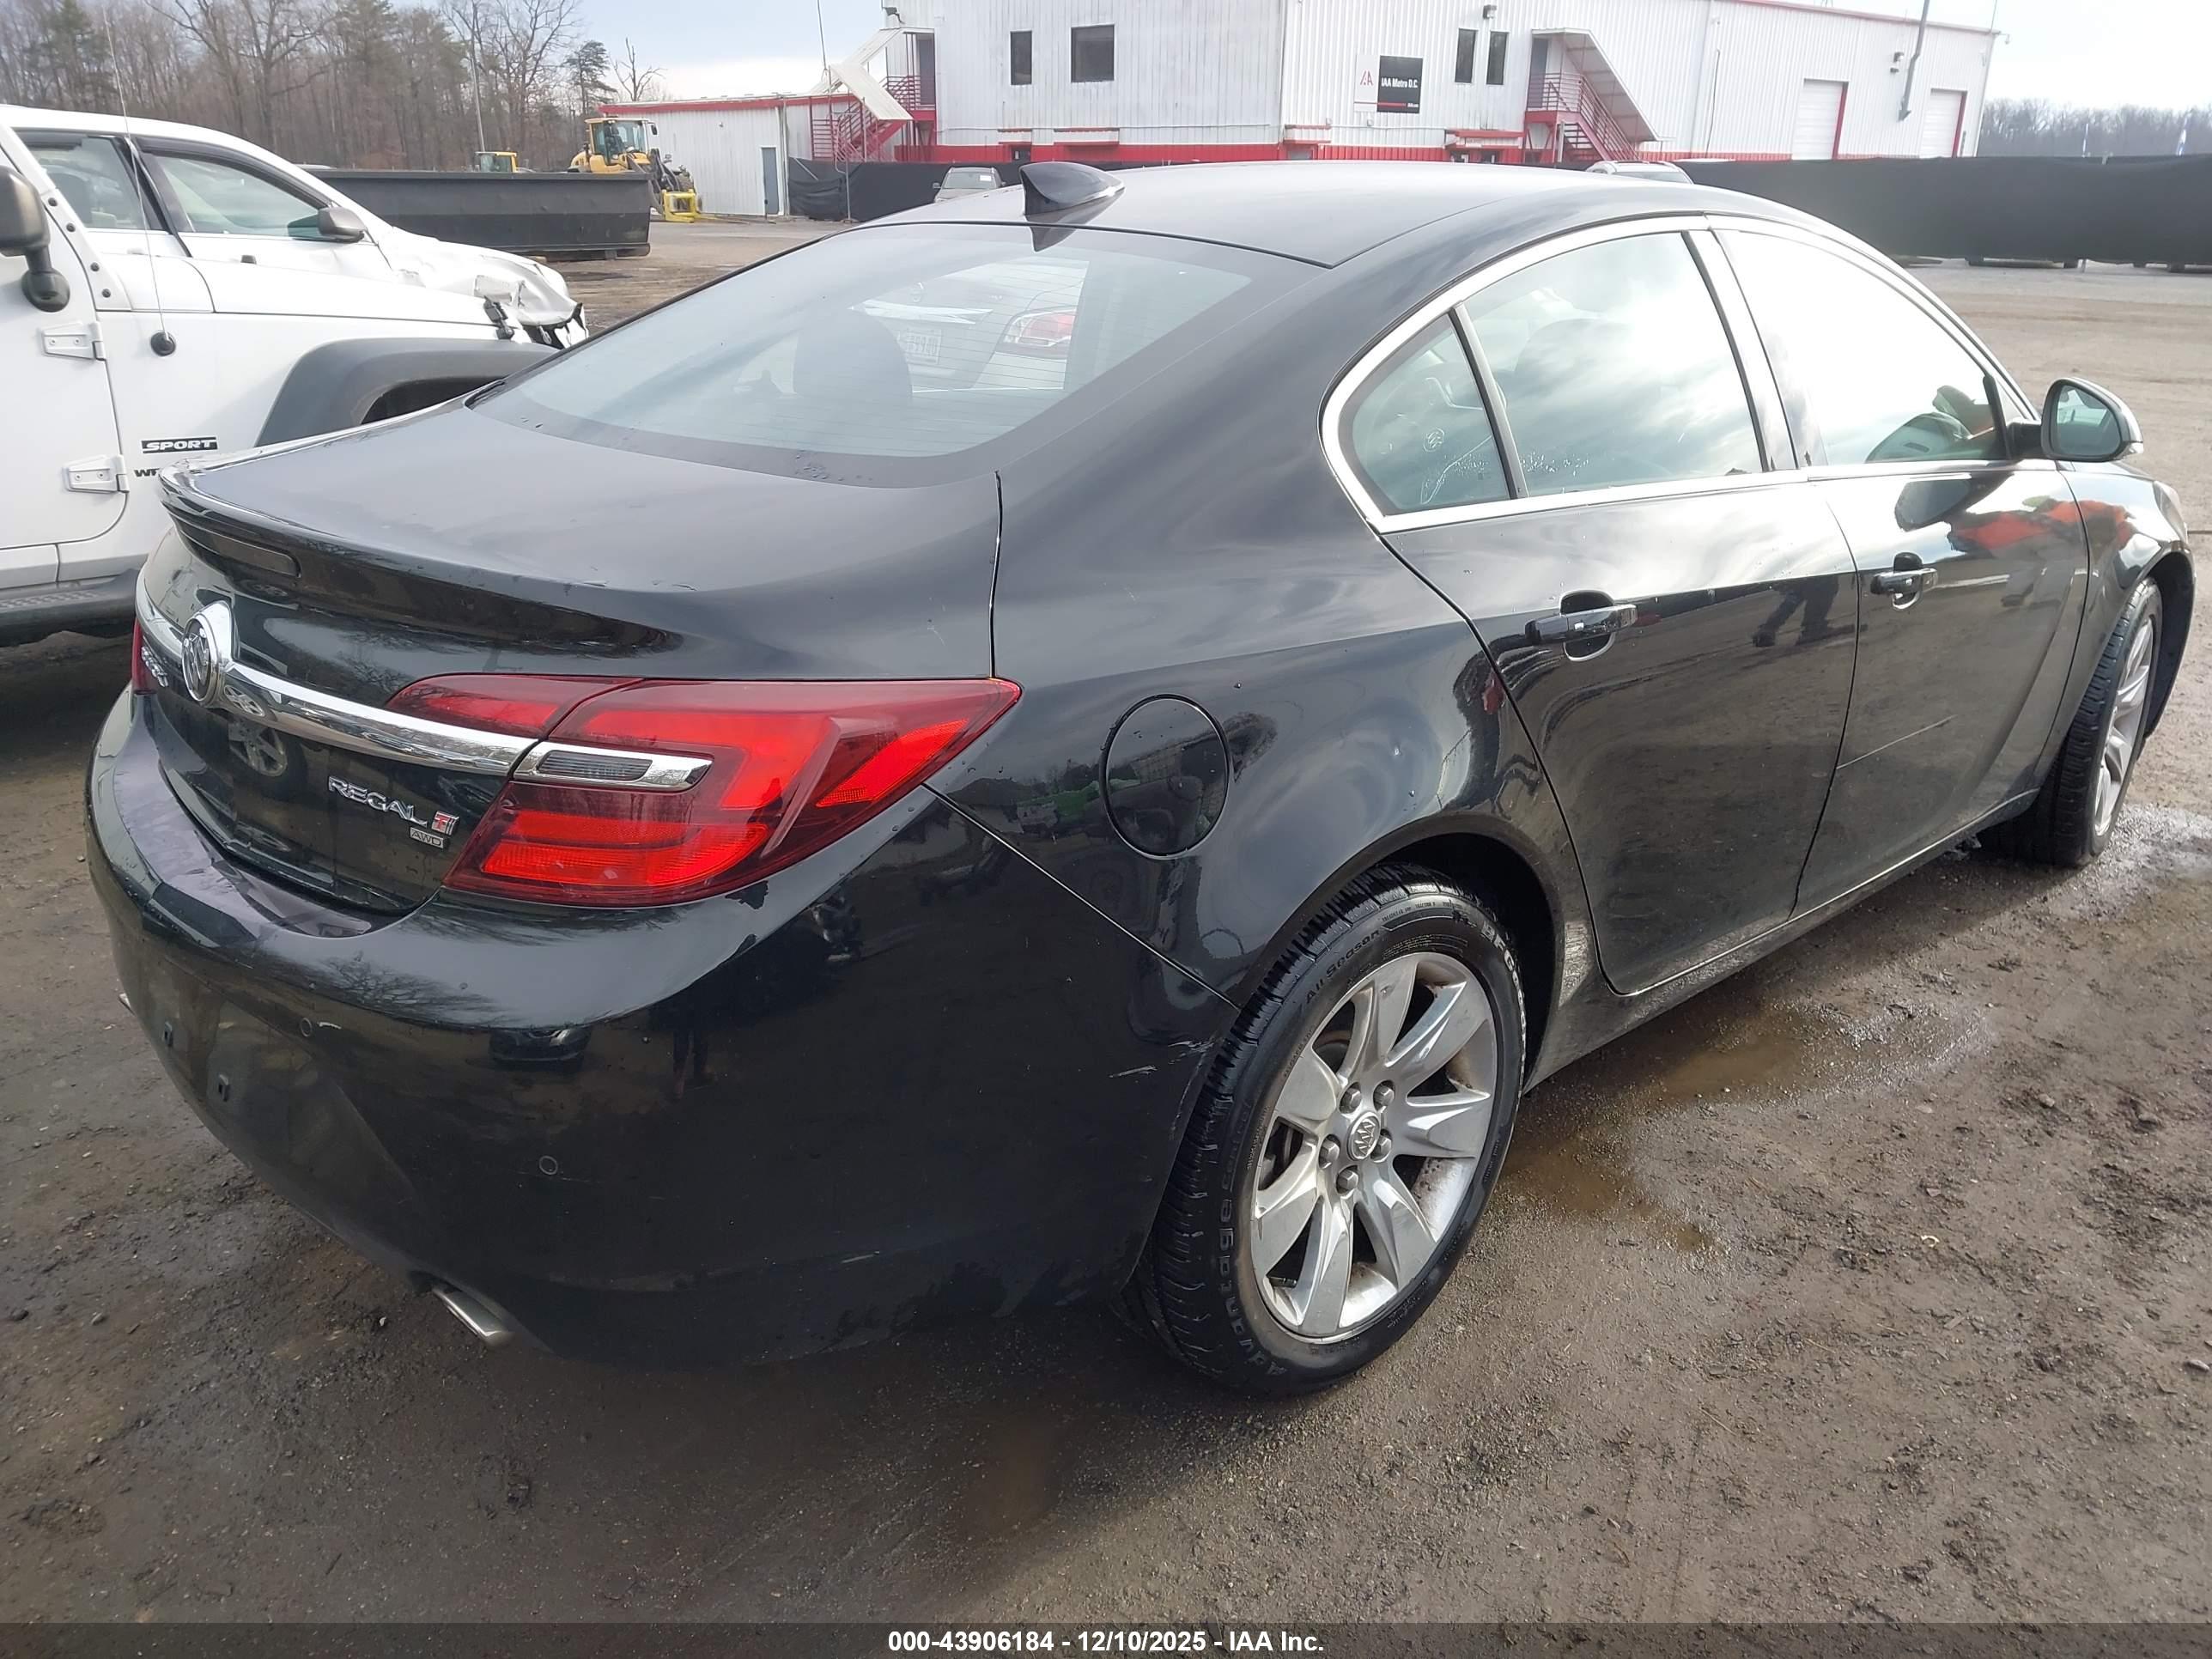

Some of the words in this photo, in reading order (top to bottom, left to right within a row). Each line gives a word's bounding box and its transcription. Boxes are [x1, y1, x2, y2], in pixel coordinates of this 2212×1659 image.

[1381, 77, 1391, 88] IAA
[1392, 78, 1407, 88] Metro
[146, 440, 216, 451] SPORT
[328, 775, 428, 829] REGAL
[411, 830, 442, 847] AWD
[1326, 929, 1380, 979] Season
